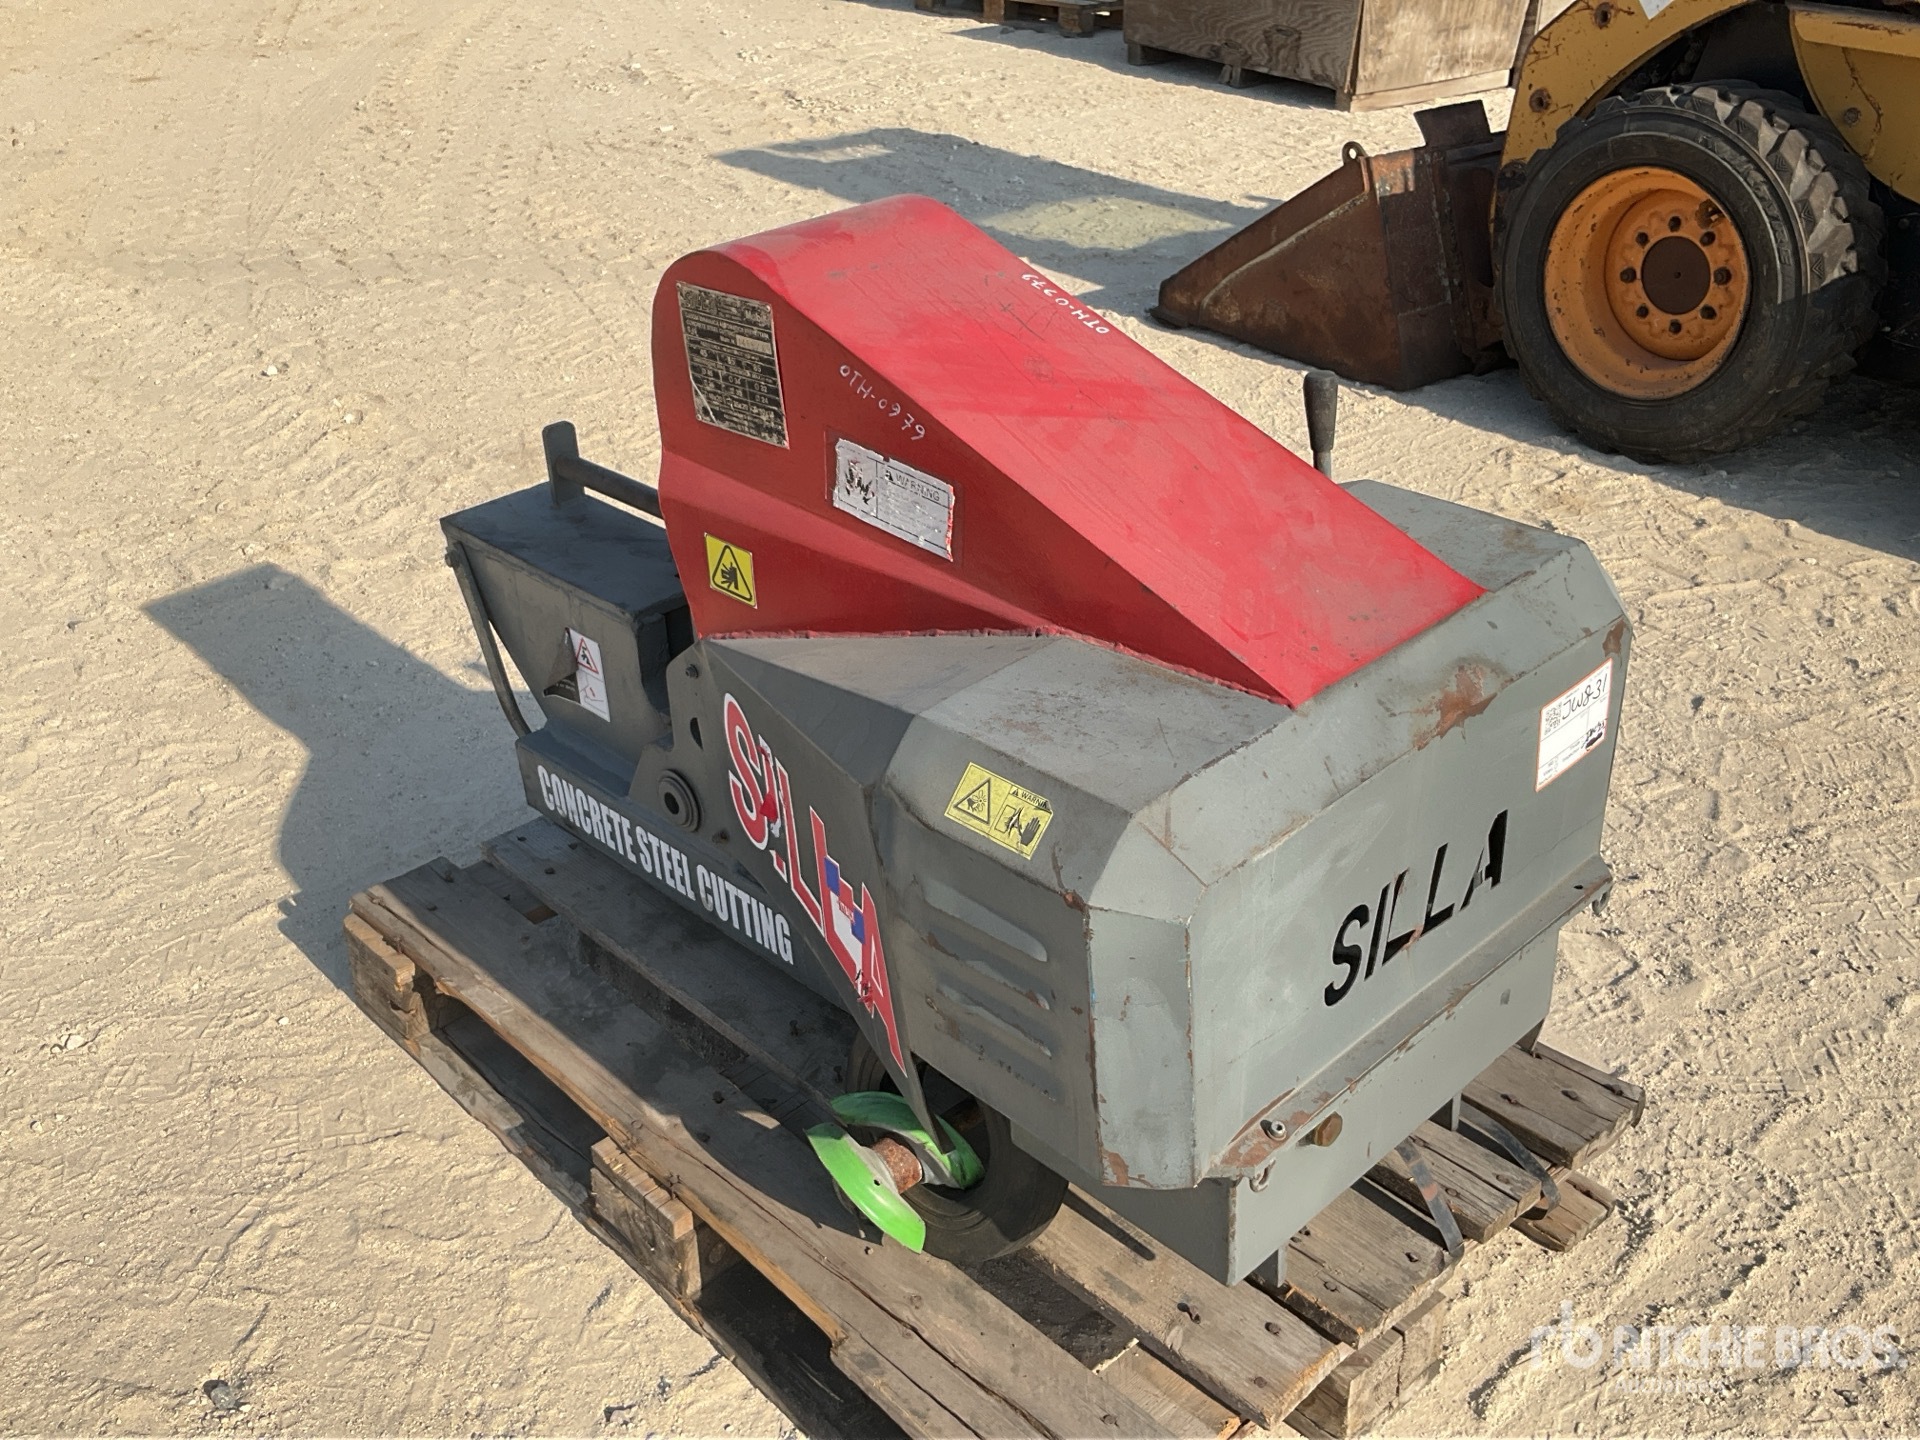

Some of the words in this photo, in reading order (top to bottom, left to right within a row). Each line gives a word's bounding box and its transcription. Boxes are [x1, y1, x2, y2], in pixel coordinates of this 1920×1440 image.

[1022, 274, 1110, 334] OTH-0979
[839, 364, 926, 441] OTH-0979
[896, 474, 940, 502] WARNING
[537, 765, 637, 864] CONCRETE
[635, 825, 696, 901] STEEL
[696, 864, 794, 965] CUTTING
[724, 693, 908, 1078] SILLA
[1324, 809, 1508, 1007] SILLA
